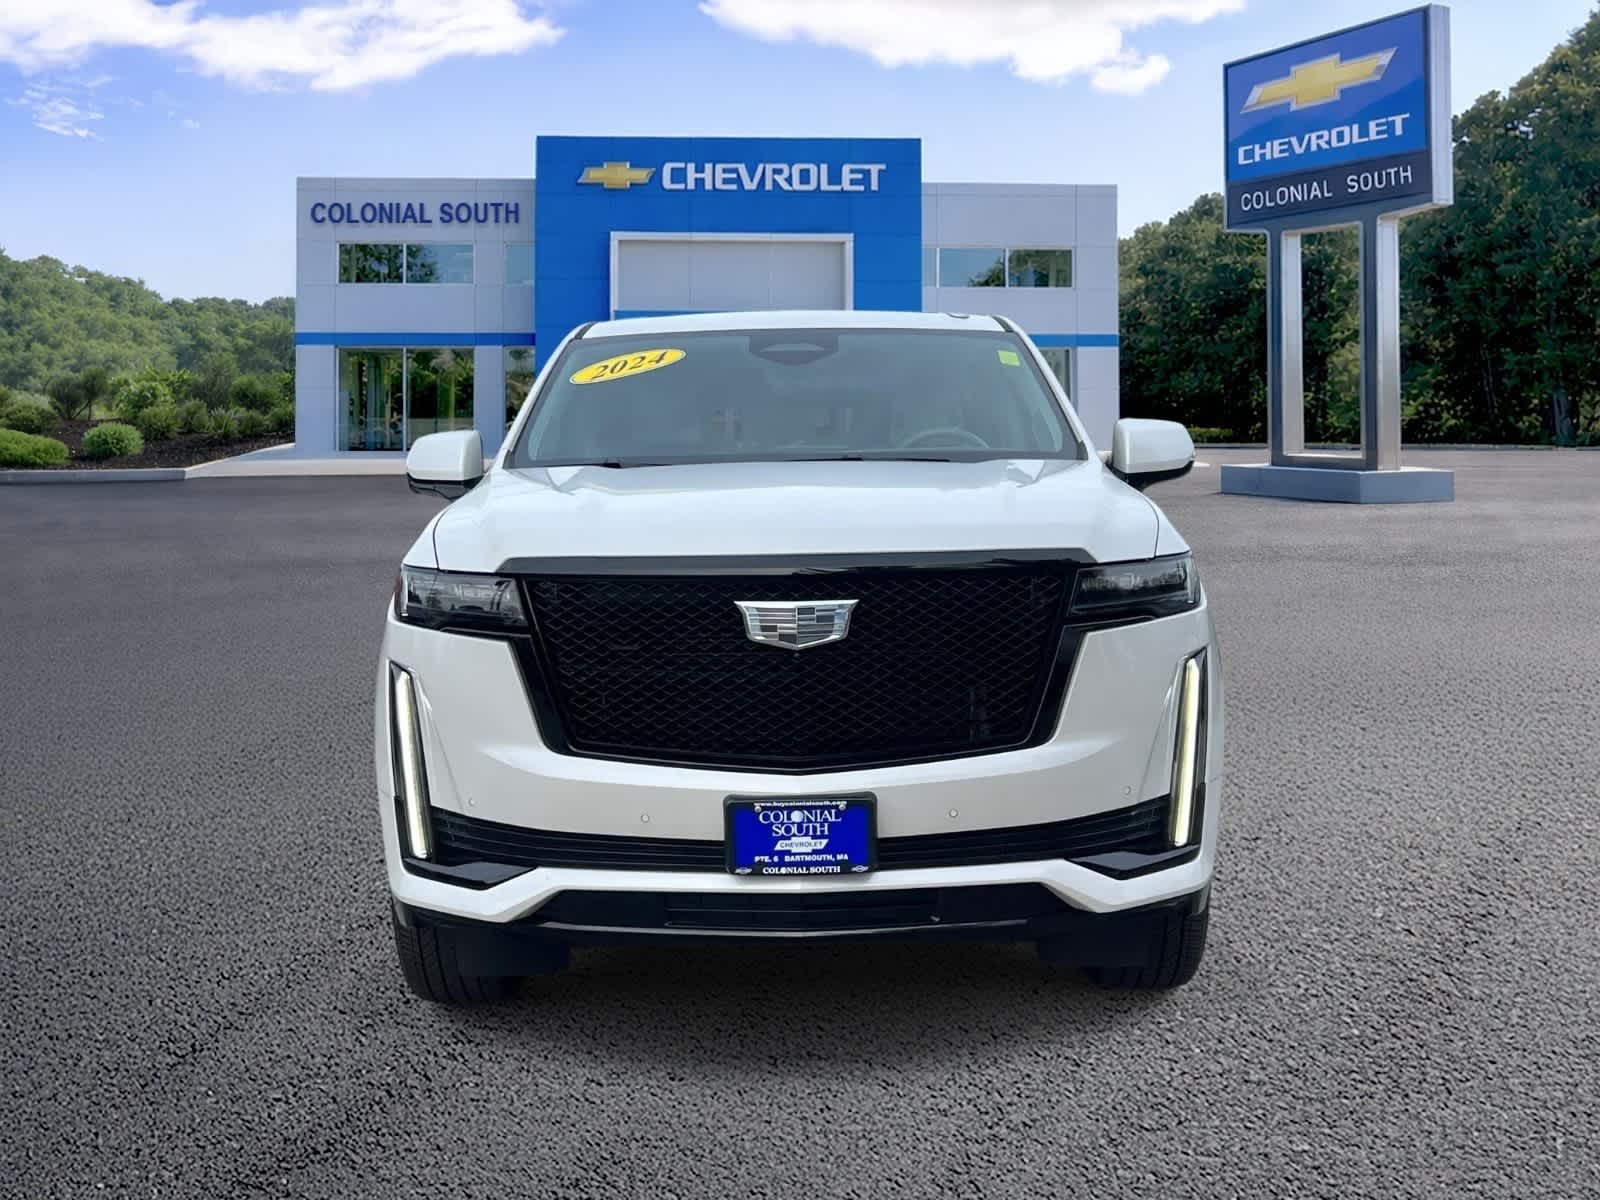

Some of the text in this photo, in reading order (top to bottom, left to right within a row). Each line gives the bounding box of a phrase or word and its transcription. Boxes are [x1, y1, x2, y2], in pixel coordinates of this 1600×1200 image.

[1237, 113, 1410, 165] CHEVROLET
[661, 161, 887, 192] CHEVROLET
[1241, 165, 1413, 212] COLONIAL SOUTH
[310, 202, 520, 224] COLONIAL SOUTH
[590, 351, 669, 380] 2024
[759, 808, 842, 824] COLONIAL
[772, 823, 829, 837] SOUTH
[779, 840, 823, 849] CHEVROLET
[762, 865, 841, 874] COLONIAL SOUTH
